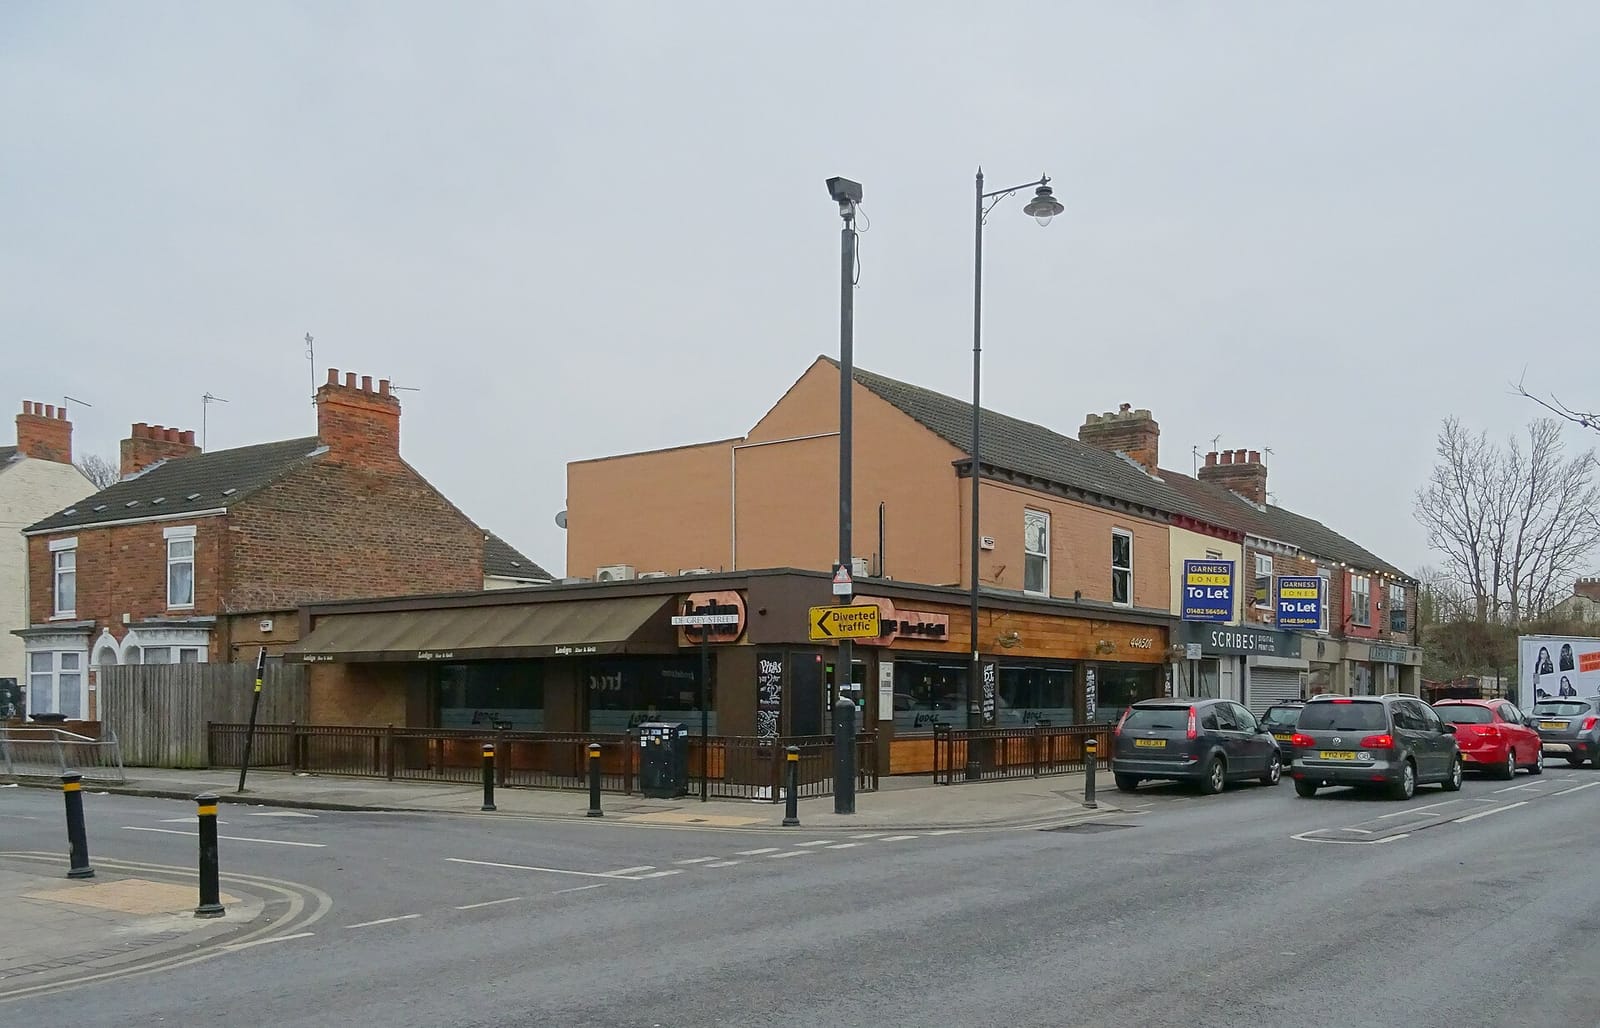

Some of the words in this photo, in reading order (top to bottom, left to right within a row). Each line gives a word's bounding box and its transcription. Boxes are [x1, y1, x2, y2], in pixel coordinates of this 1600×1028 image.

[1190, 565, 1227, 573] GARNESS
[1187, 587, 1204, 598] To
[1206, 588, 1229, 599] Let
[1280, 602, 1295, 612] To
[1297, 602, 1317, 612] Let
[686, 616, 705, 624] GREY
[707, 615, 735, 623] STREET
[832, 611, 876, 622] Diverted
[838, 622, 870, 632] traffic
[1211, 630, 1254, 650] SCRIBES
